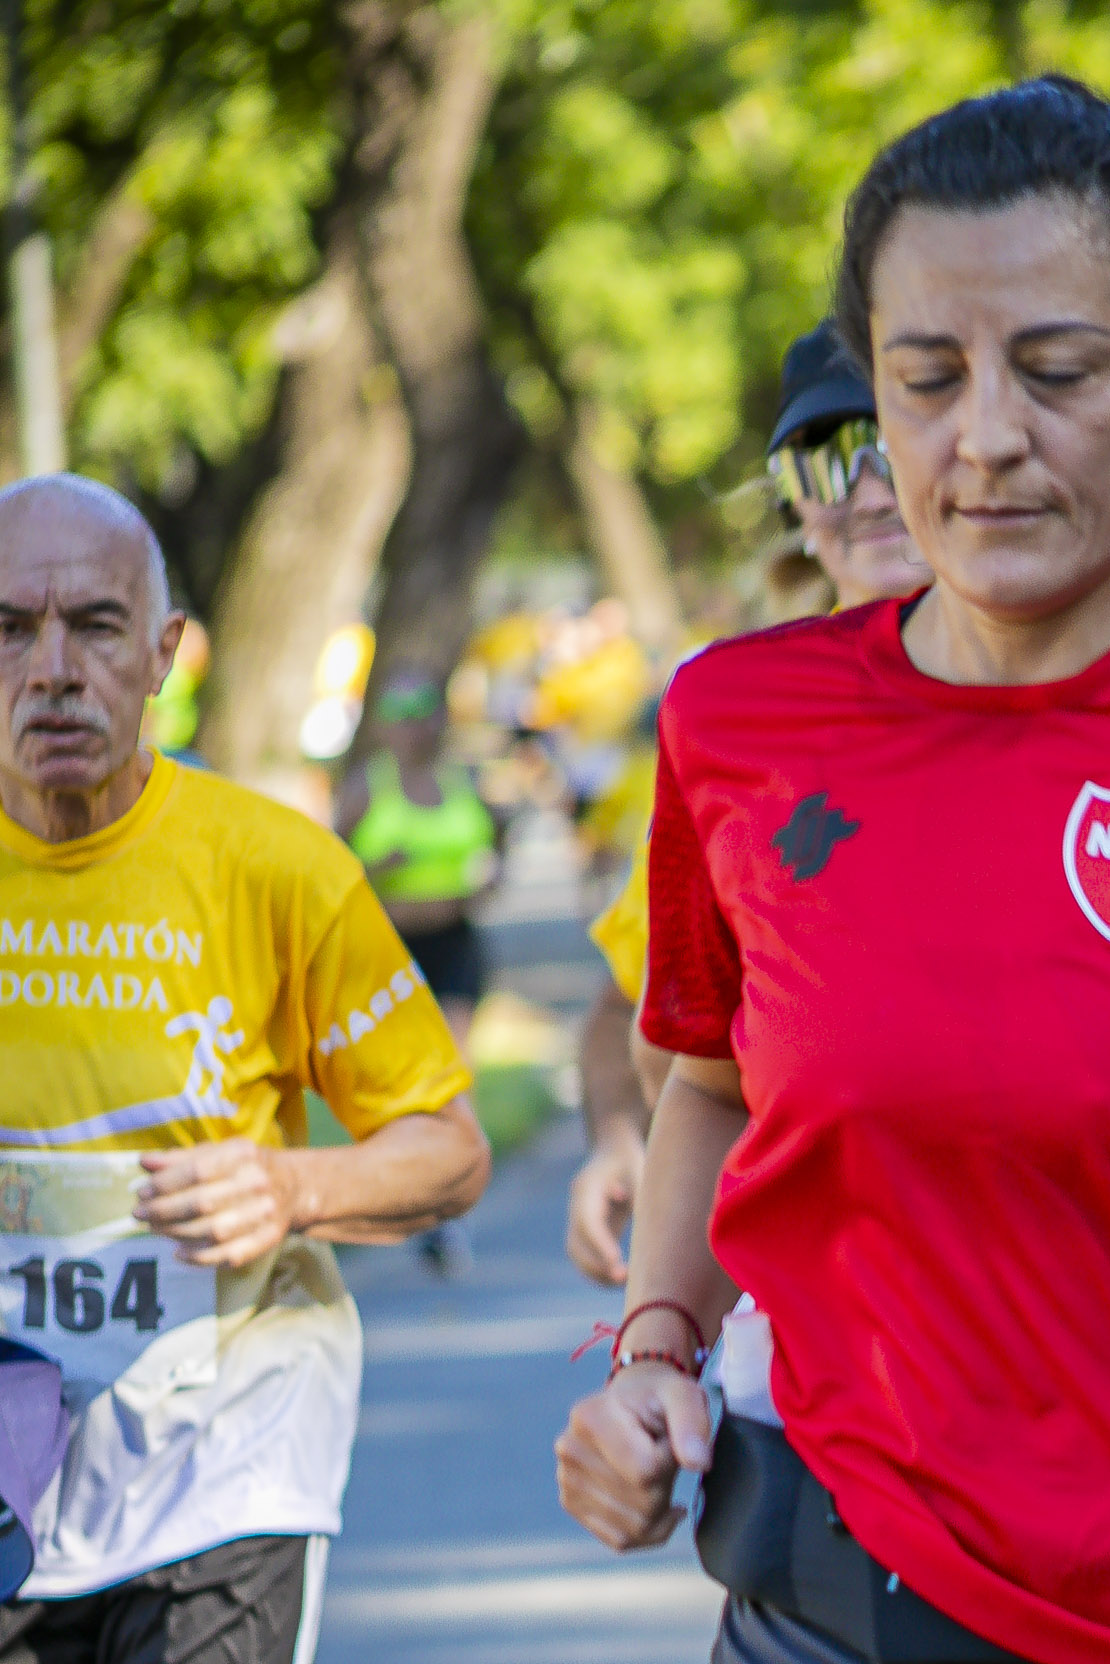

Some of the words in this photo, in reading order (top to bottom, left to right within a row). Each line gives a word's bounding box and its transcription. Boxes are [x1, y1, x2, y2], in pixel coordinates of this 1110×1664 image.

[0, 917, 202, 969] MARATÓN
[0, 969, 169, 1013] DORADA
[9, 1256, 165, 1334] 164
